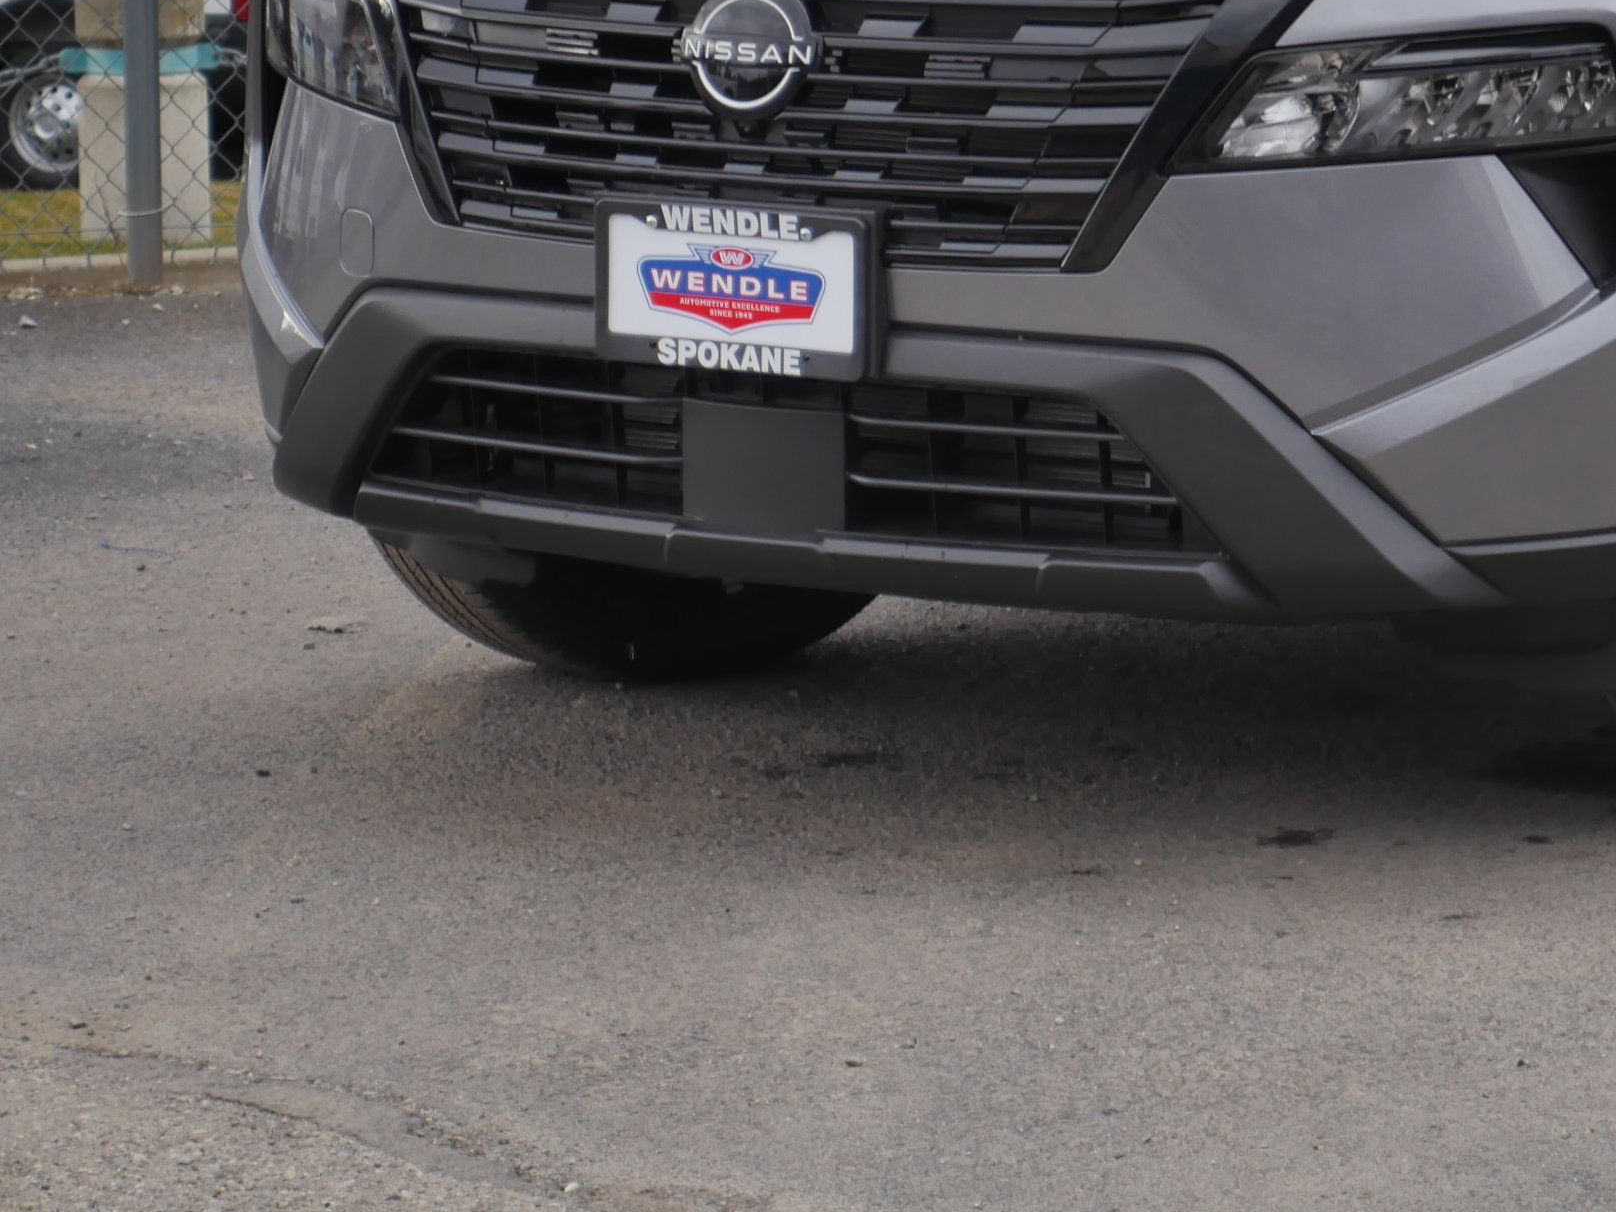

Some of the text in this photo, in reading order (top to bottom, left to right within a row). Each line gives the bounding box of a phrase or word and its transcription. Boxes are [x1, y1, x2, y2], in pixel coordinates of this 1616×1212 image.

[684, 38, 812, 65] NISSAN
[660, 203, 800, 241] WENDLE
[650, 268, 808, 301] WENDLE
[679, 296, 780, 313] AUTOMOTIVE EXCELLENCE
[709, 309, 753, 320] SINCE 1943
[657, 337, 801, 376] SPOKANE
